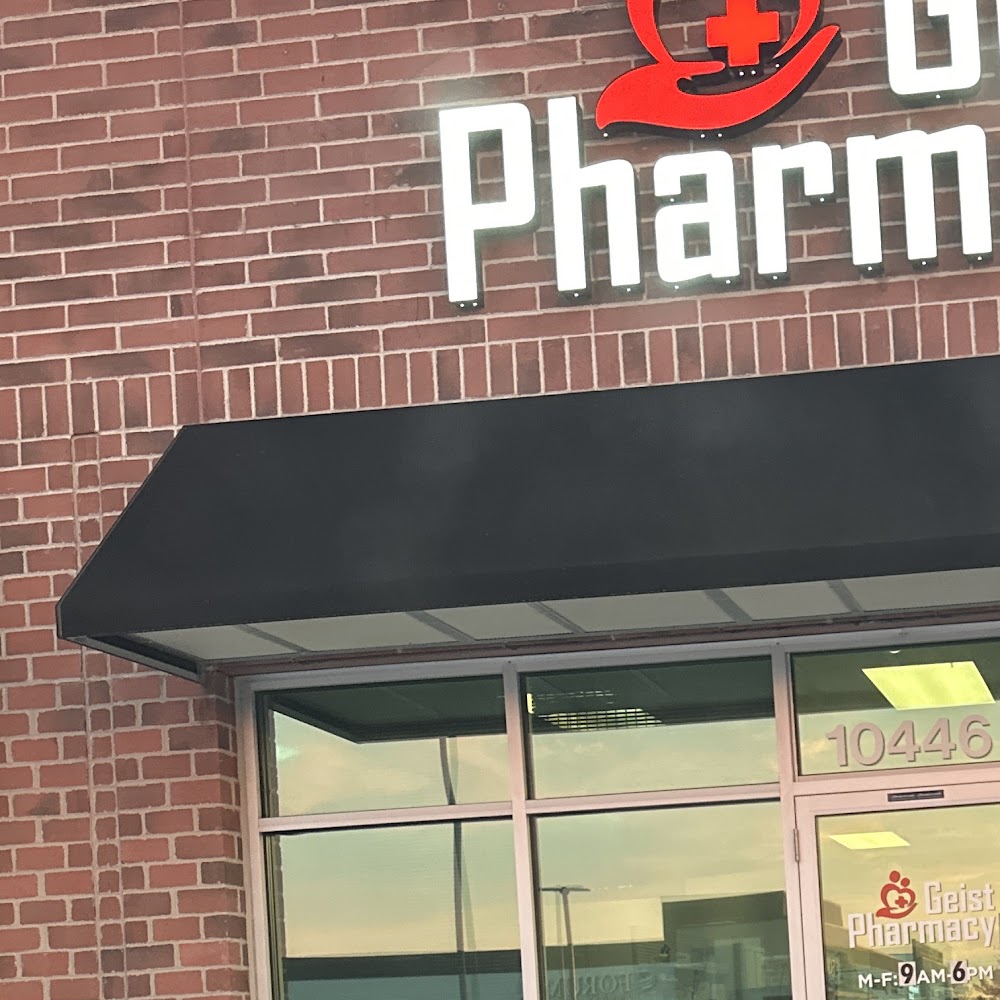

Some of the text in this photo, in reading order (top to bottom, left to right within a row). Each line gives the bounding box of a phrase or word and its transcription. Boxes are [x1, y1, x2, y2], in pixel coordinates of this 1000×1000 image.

[826, 714, 993, 766] 10446
[924, 880, 996, 914] Geist
[848, 913, 997, 948] Pharmacy
